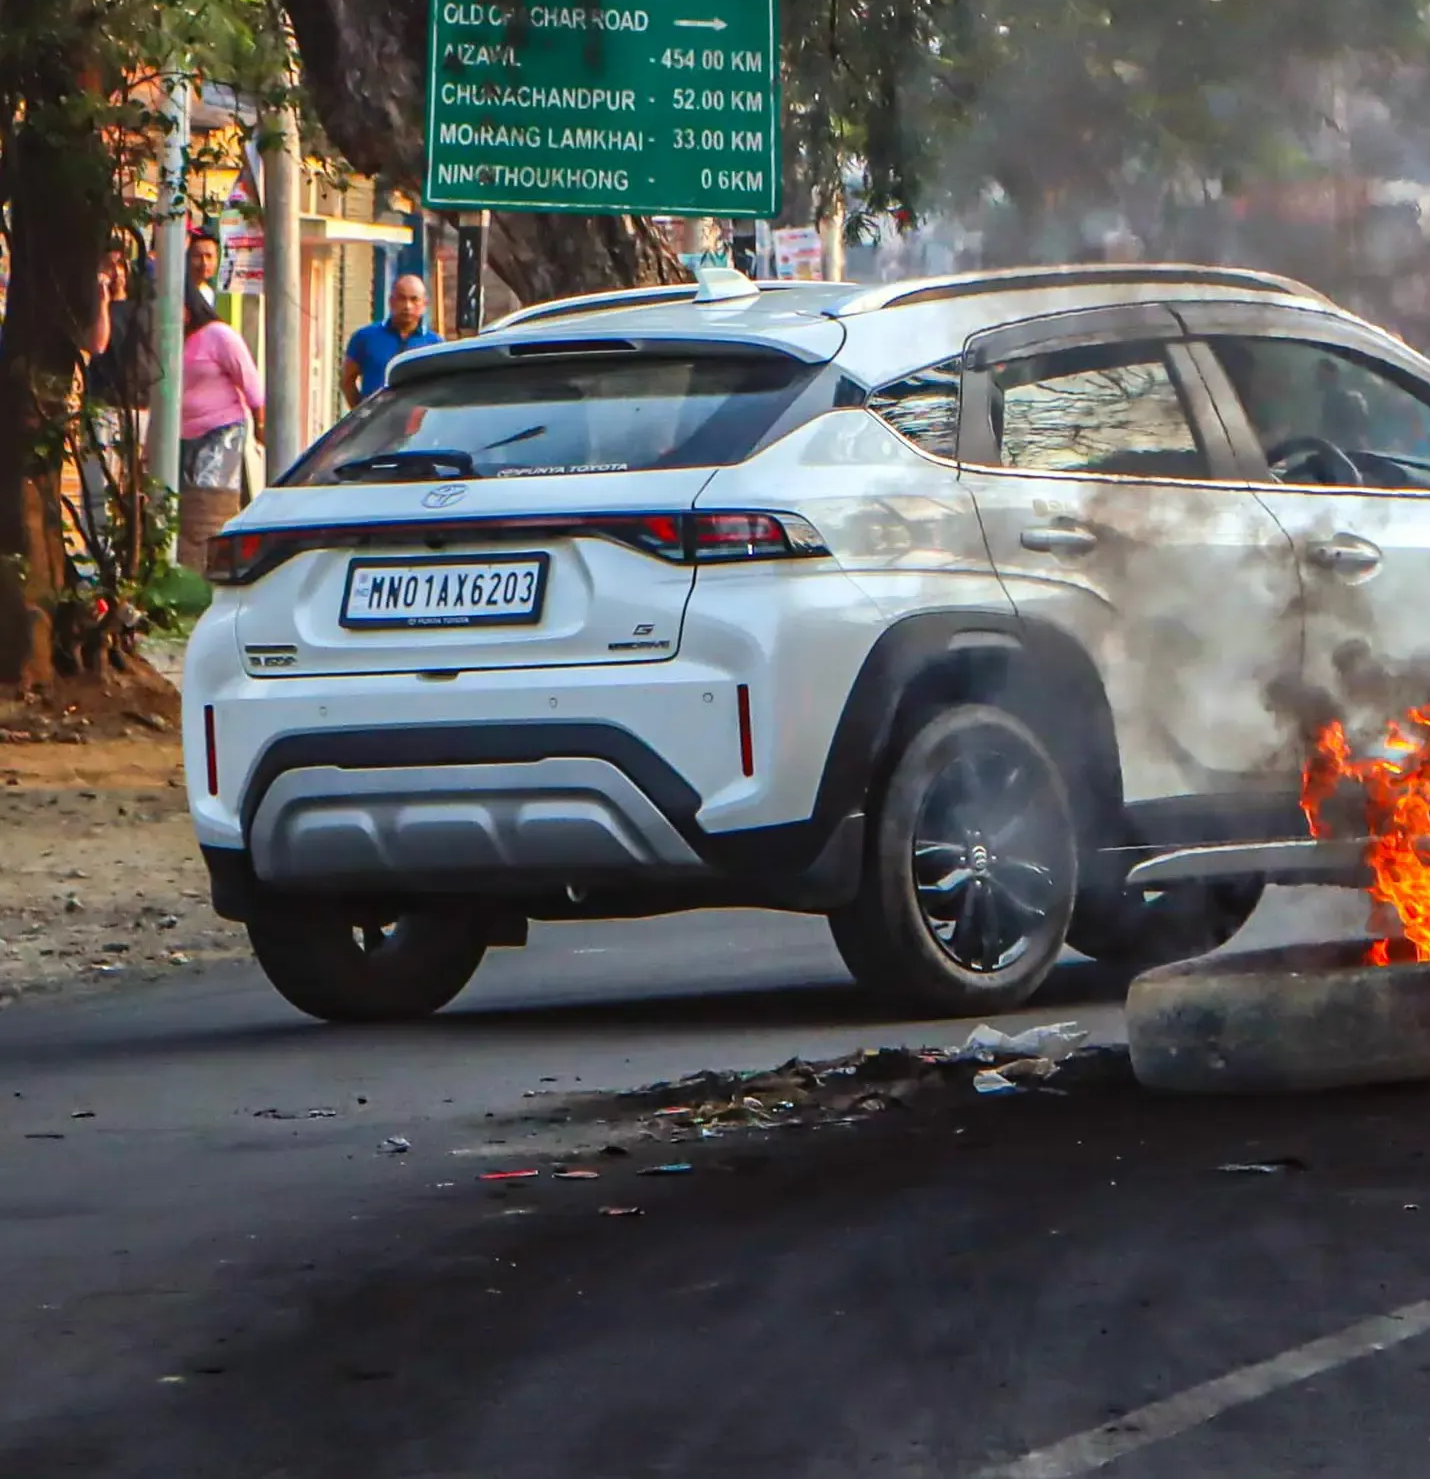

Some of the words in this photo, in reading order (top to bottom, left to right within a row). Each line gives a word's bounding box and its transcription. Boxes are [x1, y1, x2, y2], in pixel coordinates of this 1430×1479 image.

[443, 2, 483, 25] OLD
[731, 51, 762, 73] KM
[441, 83, 636, 111] CHURACHANDPUR
[672, 88, 724, 111] 52.00
[731, 90, 763, 113] KM
[439, 123, 541, 148] MOIRANG
[548, 127, 644, 151] LAMKHAI
[673, 128, 724, 151] 33.00
[731, 130, 763, 152] KM
[570, 463, 629, 473] TOYOTA
[368, 571, 535, 609] MN01AX6203
